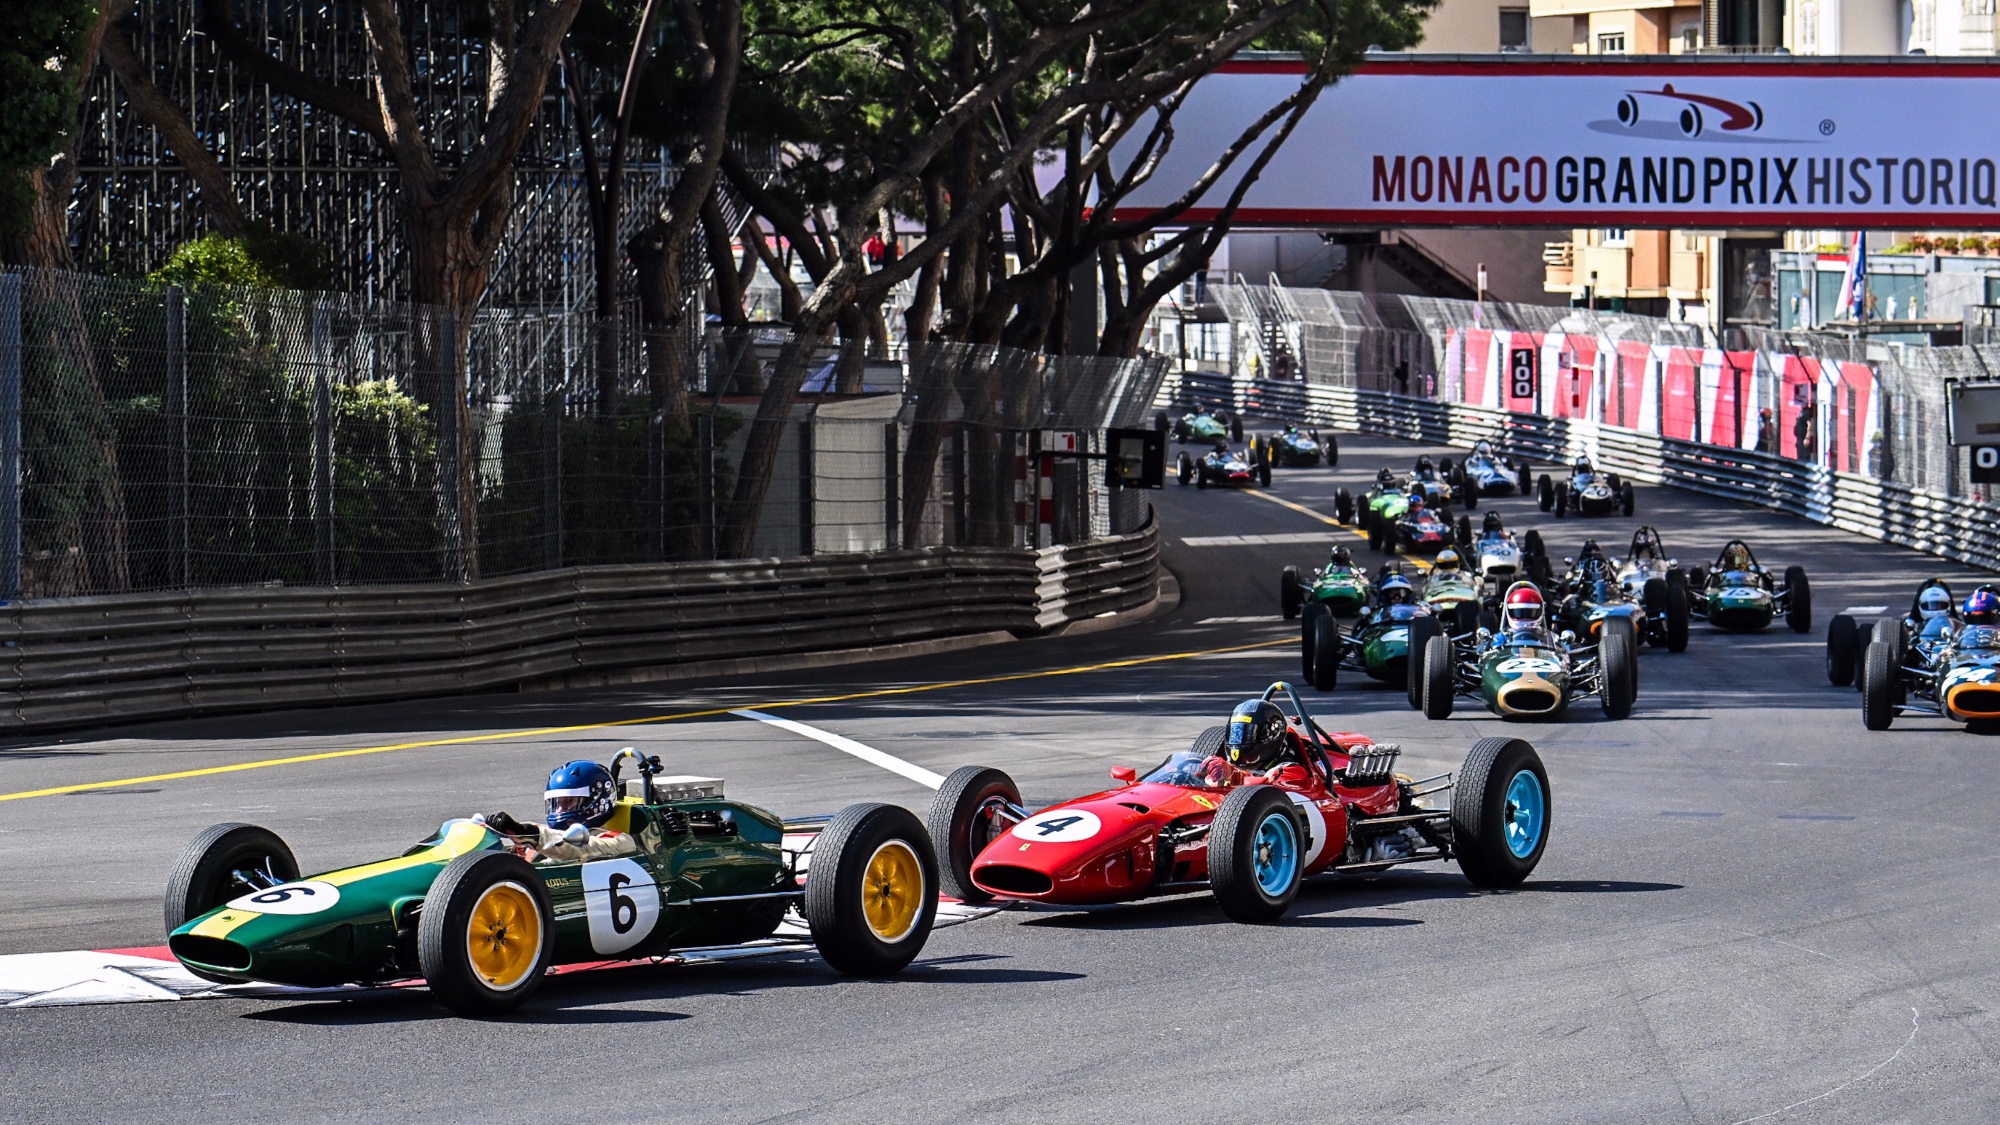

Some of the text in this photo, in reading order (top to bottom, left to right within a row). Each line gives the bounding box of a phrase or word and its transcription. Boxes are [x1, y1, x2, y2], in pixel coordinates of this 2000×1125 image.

[1372, 155, 1996, 208] MONACO GRAND PRIX HISTORIQ
[1515, 351, 1530, 396] 100
[1506, 661, 1552, 670] 22
[1035, 816, 1084, 836] 4
[251, 887, 315, 903] 6
[609, 872, 637, 935] 6
